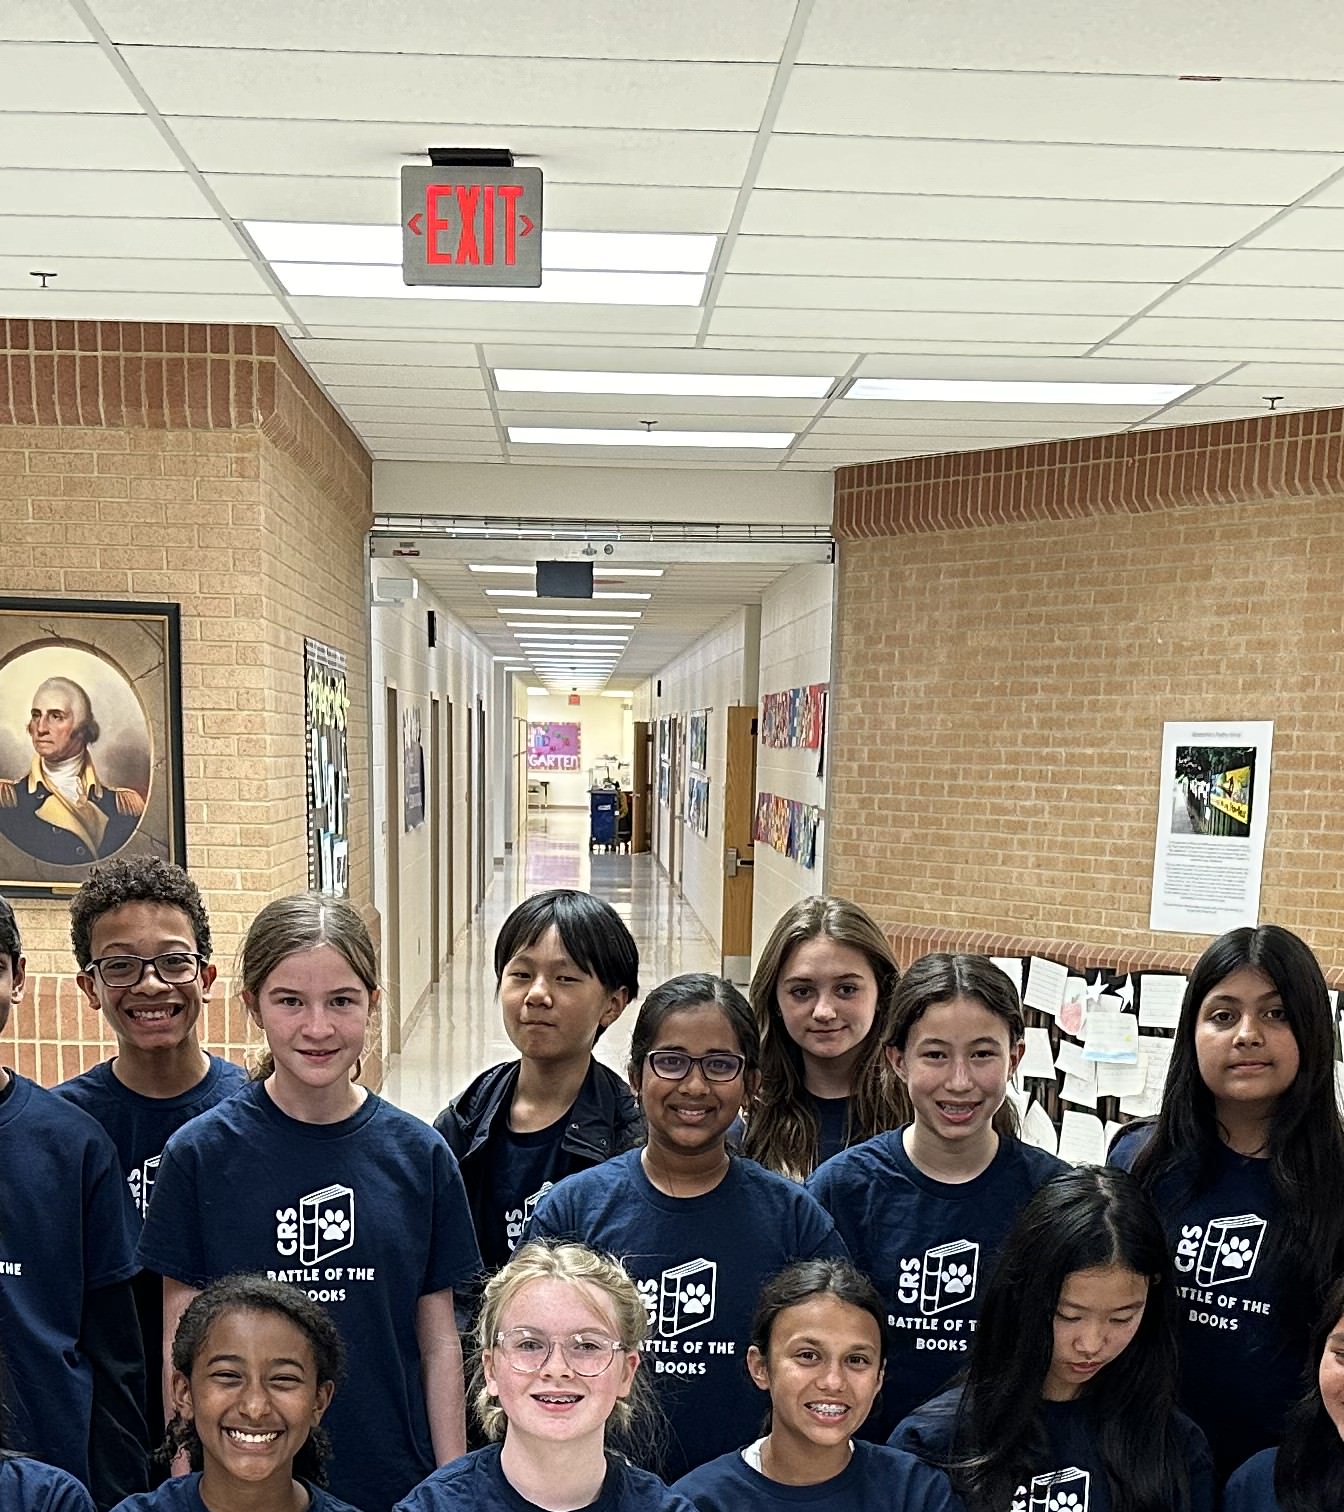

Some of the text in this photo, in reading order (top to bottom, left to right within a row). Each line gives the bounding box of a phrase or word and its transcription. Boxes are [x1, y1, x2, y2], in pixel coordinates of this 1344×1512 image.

[425, 184, 524, 266] EXIT
[276, 1207, 298, 1256] CRS
[1174, 1224, 1203, 1273] CRS
[266, 1268, 375, 1282] BATTLE OF THE
[897, 1258, 921, 1304] CRS
[303, 1289, 346, 1302] OOKS
[1217, 1294, 1237, 1309] OF
[1242, 1299, 1271, 1315] THE
[888, 1315, 939, 1330] BATTLE
[943, 1319, 963, 1331] OF
[1189, 1310, 1239, 1330] BOOKS
[683, 1341, 703, 1354] OF
[708, 1342, 735, 1355] THE
[916, 1338, 967, 1351] BOOKS
[656, 1361, 706, 1374] BOOKS
